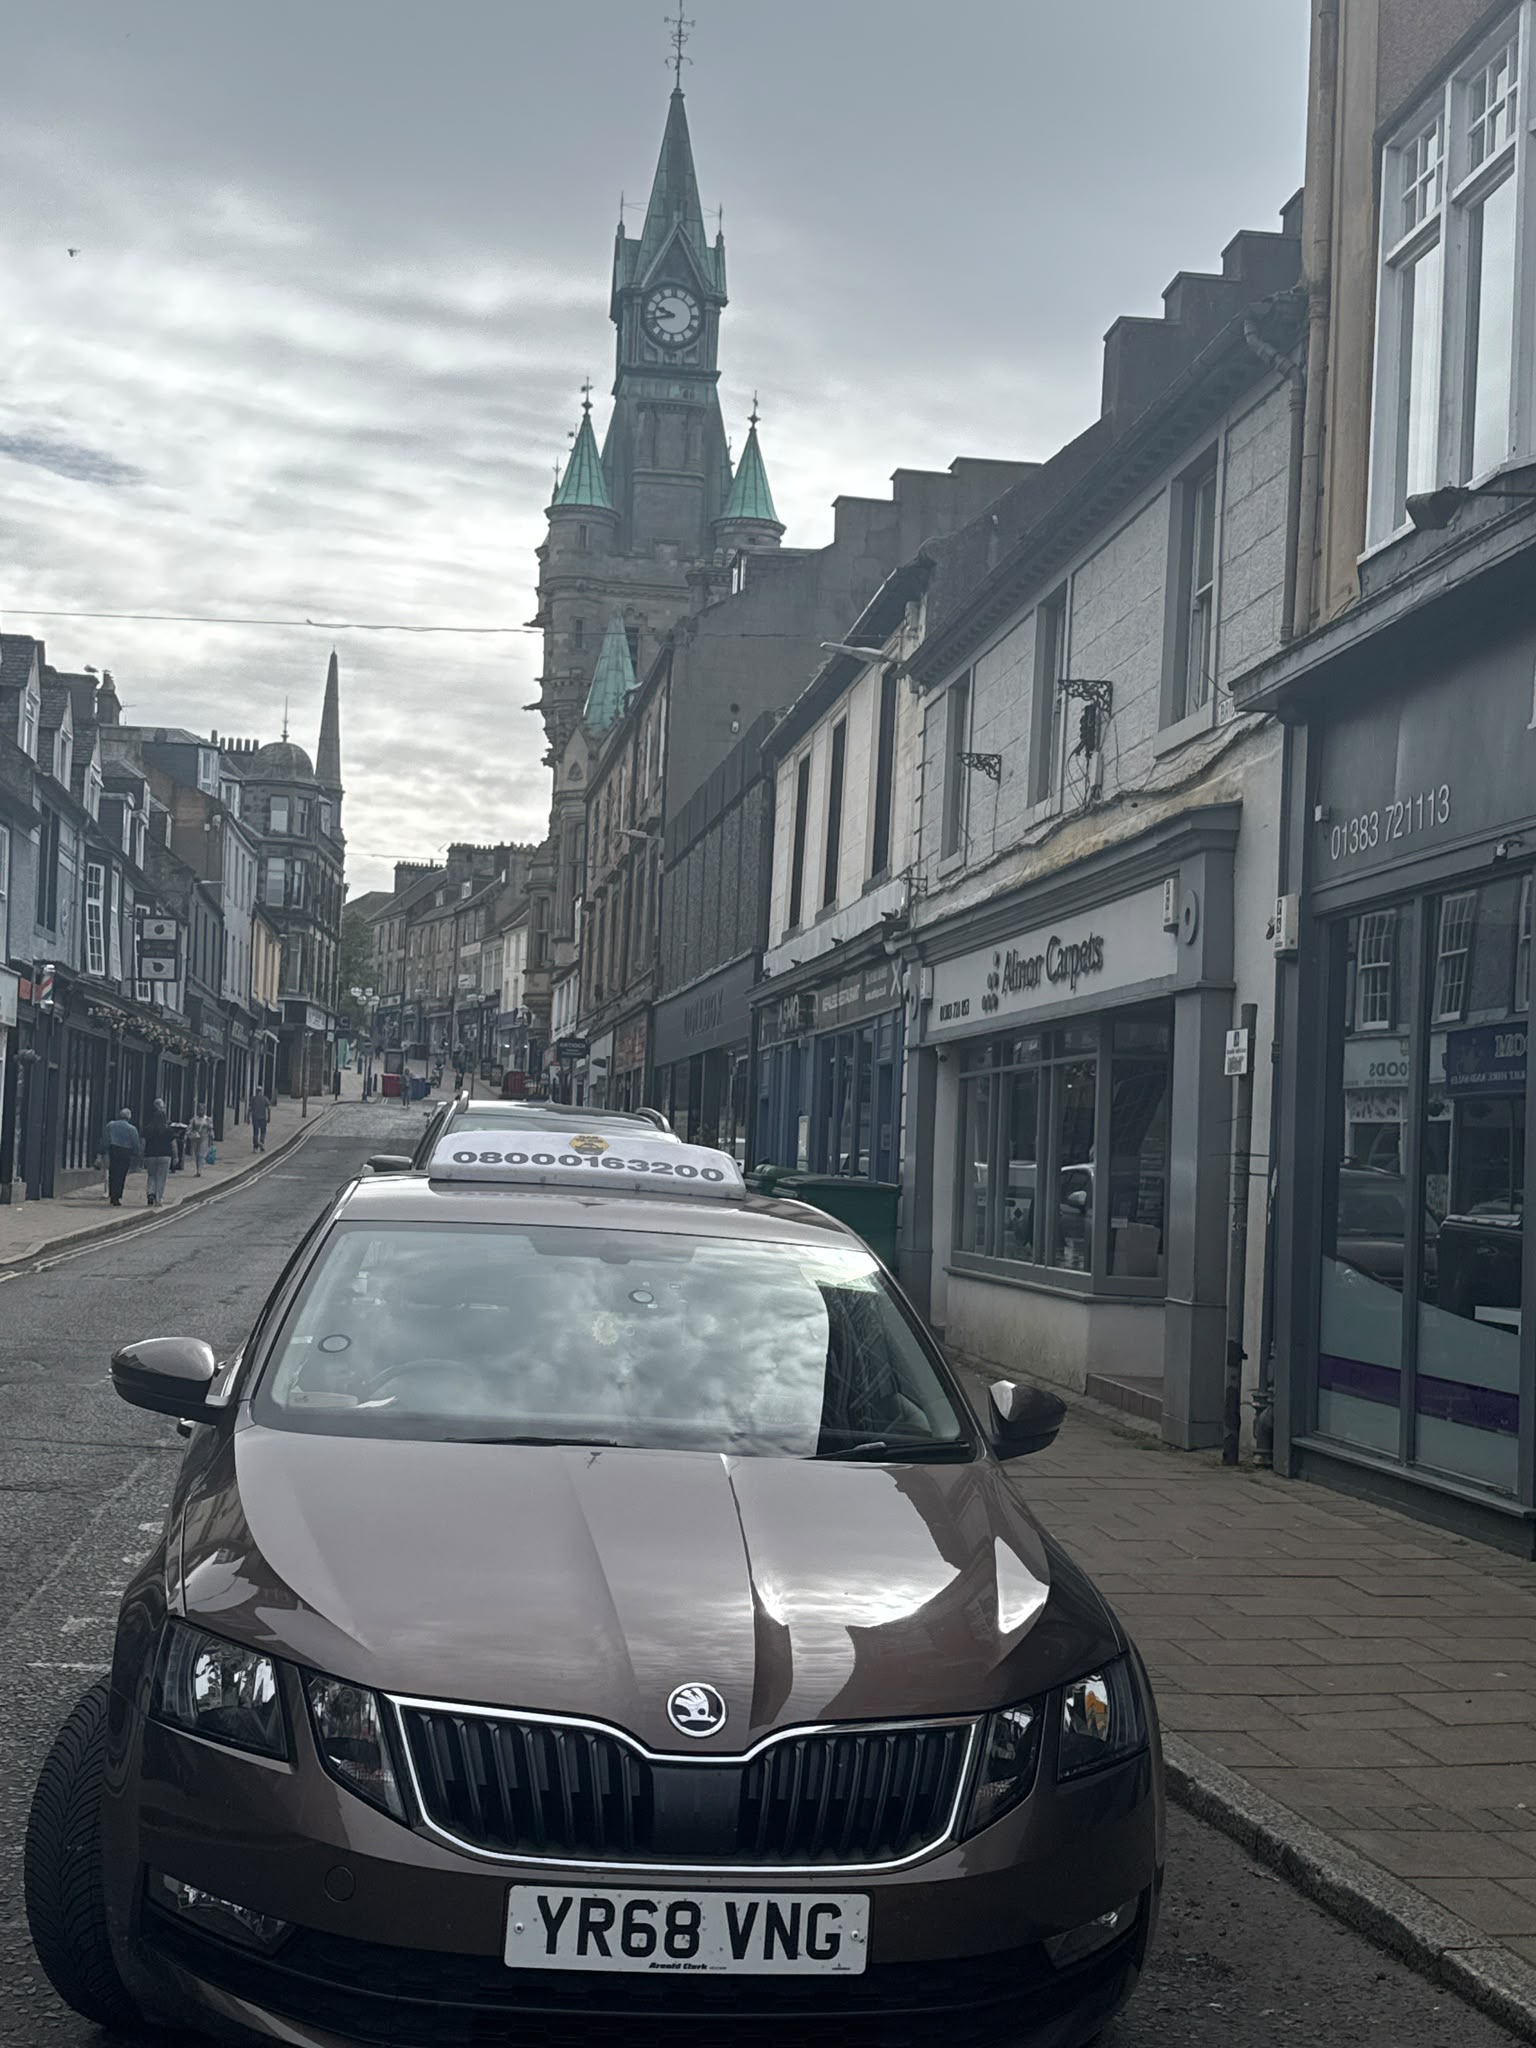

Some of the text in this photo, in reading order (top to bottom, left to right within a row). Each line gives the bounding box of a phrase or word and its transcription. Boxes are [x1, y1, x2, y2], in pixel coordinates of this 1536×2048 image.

[1331, 784, 1450, 860] 01383 721113
[1046, 932, 1104, 993] Carpets
[453, 1151, 725, 1182] 08000163200
[537, 1896, 842, 1960] YR68 VNG
[648, 1962, 681, 1970] Arnold
